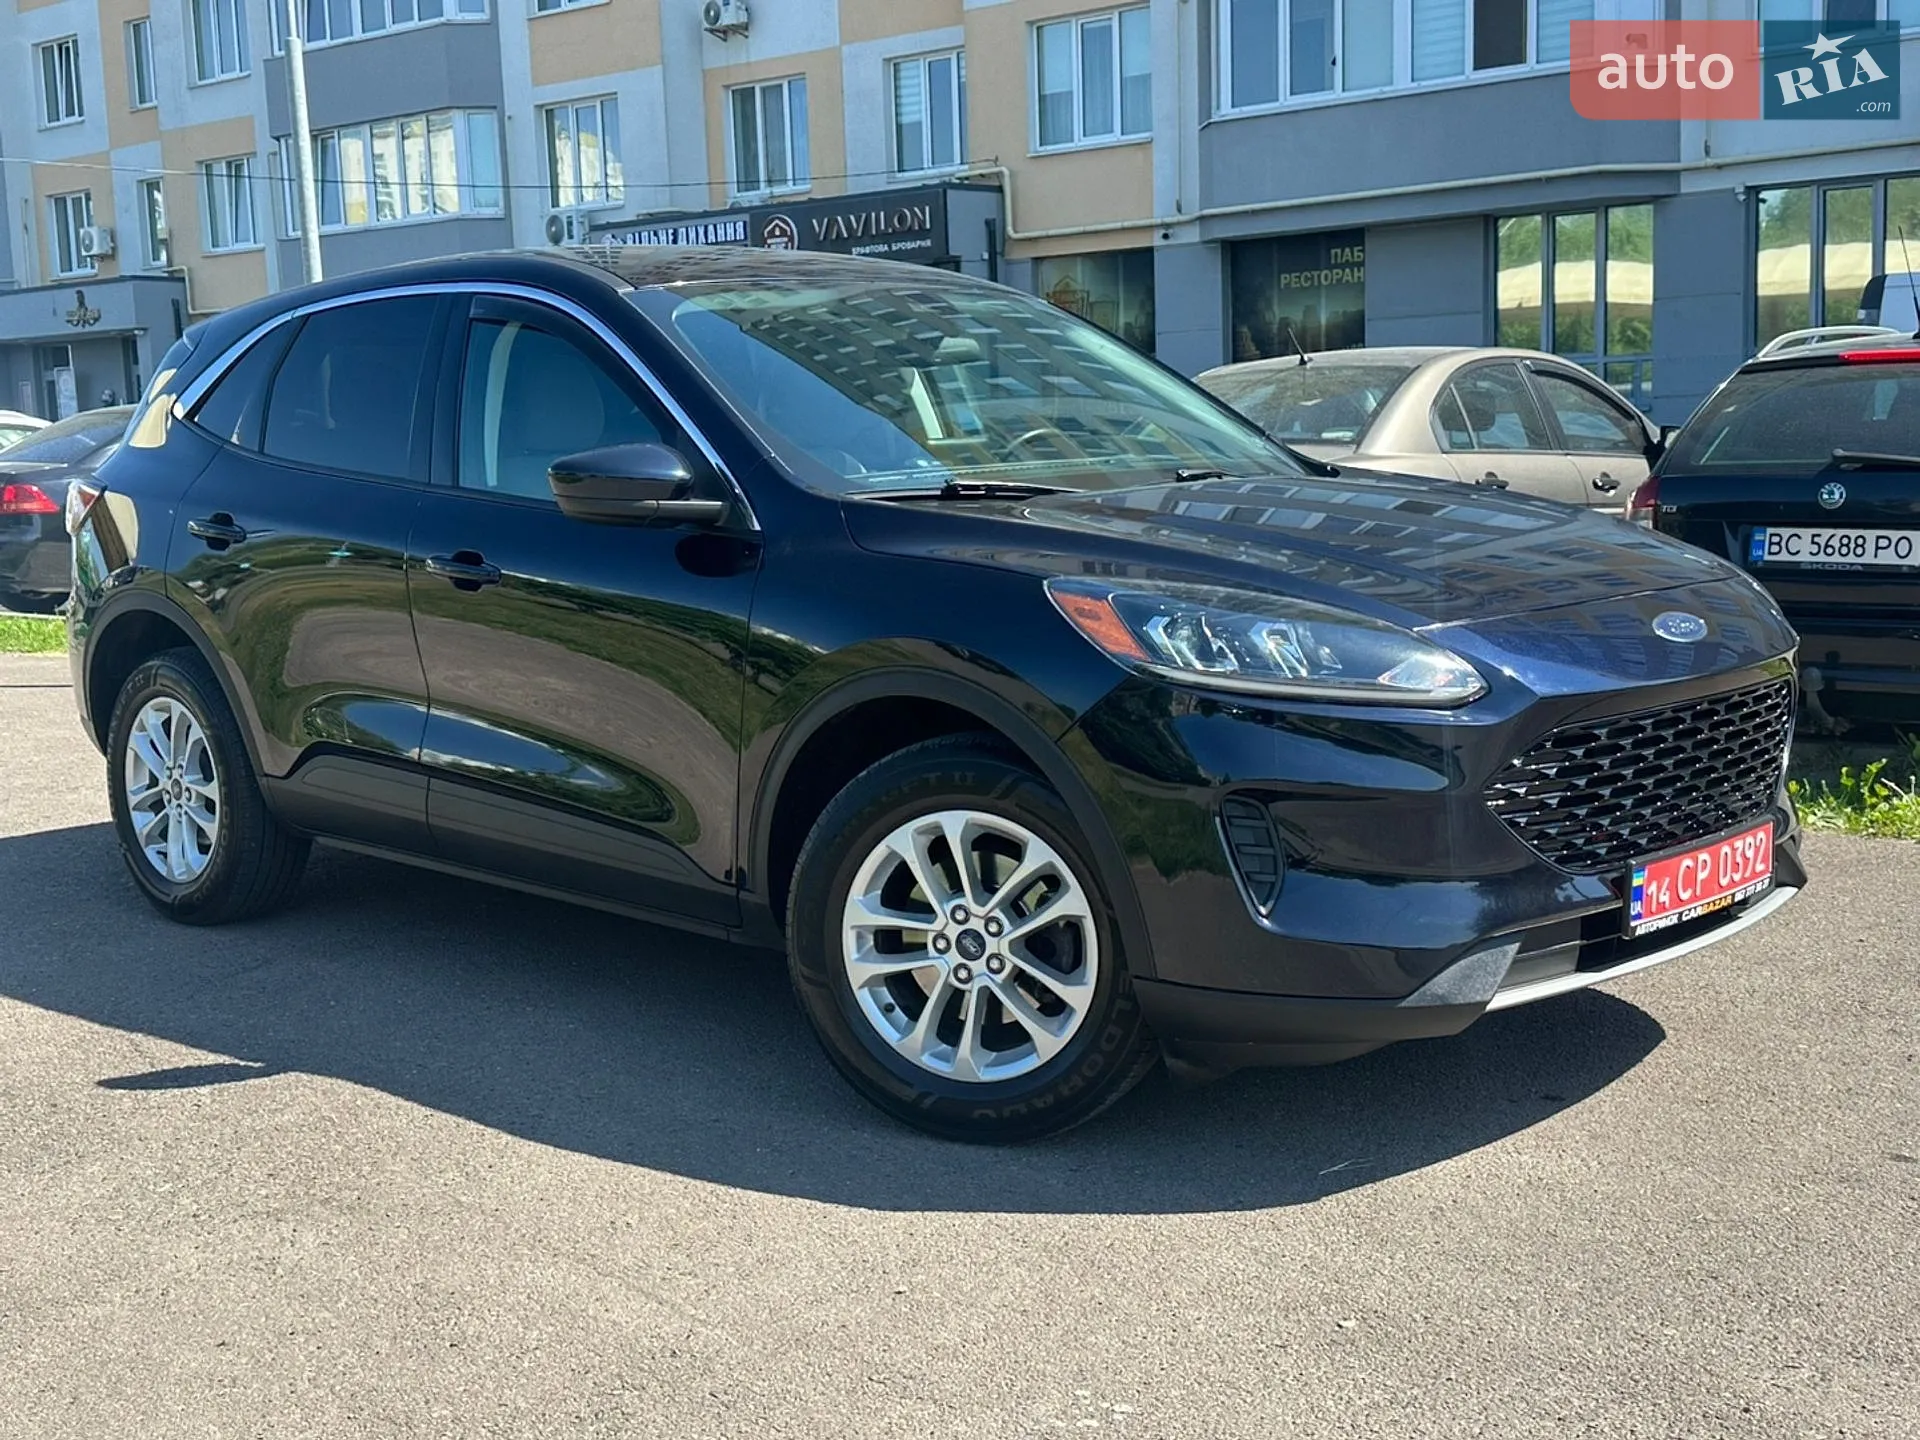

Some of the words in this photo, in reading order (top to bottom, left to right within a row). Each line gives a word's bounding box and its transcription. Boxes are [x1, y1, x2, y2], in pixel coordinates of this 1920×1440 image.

[812, 205, 930, 242] VAVILON
[1330, 246, 1365, 265] ПАБ
[1280, 266, 1365, 290] РЕСТОРАН
[1767, 532, 1803, 557] BC
[1808, 533, 1867, 558] 5688
[1873, 535, 1913, 560] PO
[1647, 876, 1671, 914] 14
[1676, 851, 1712, 902] CP
[1718, 830, 1768, 888] 0392
[1630, 900, 1643, 915] UA
